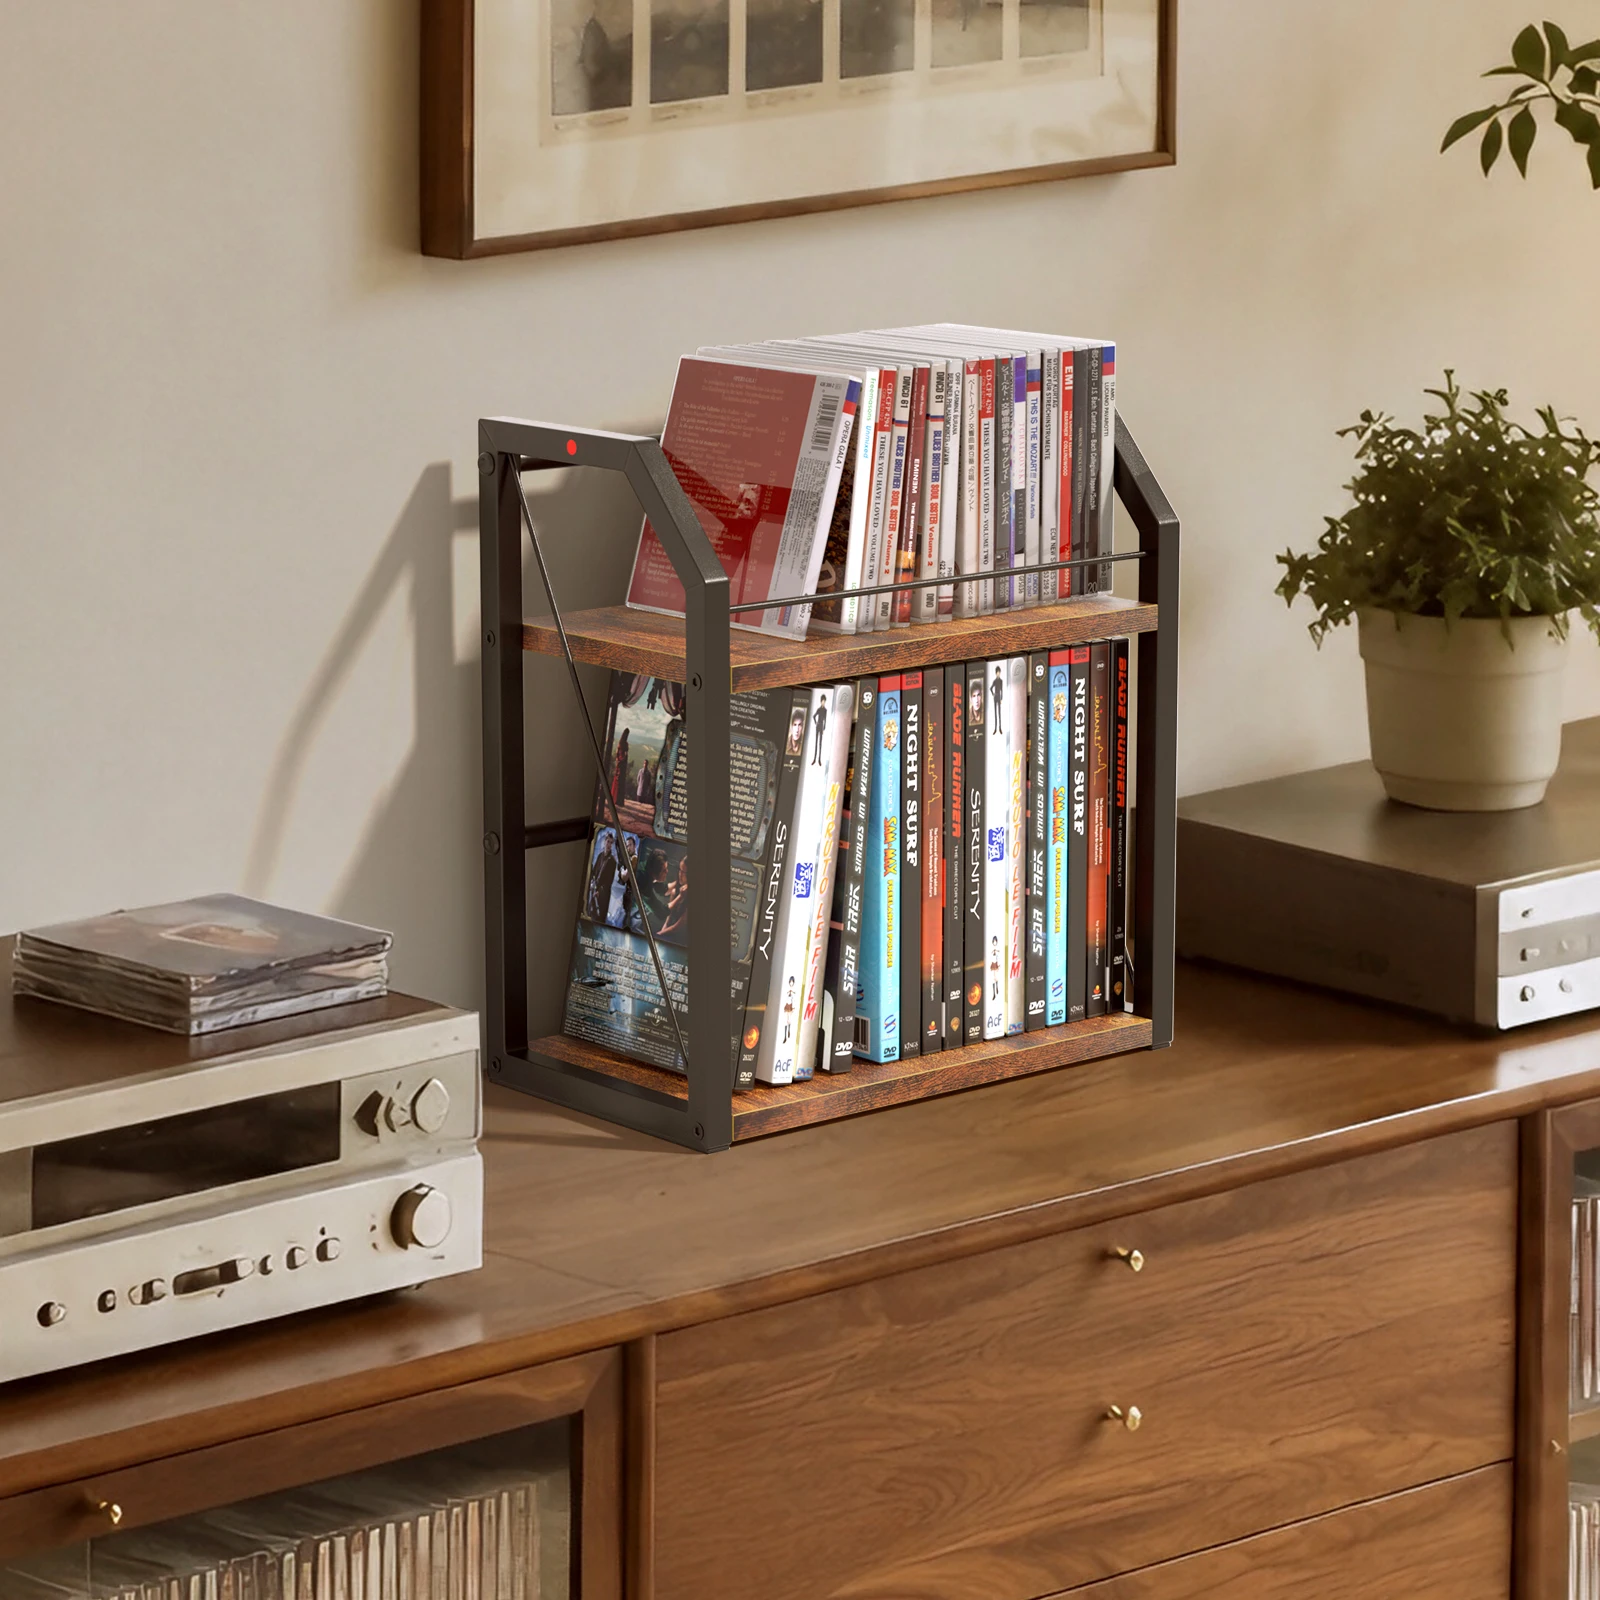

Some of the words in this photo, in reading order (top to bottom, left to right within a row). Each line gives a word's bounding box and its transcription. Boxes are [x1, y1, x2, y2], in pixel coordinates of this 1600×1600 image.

[903, 376, 911, 398] DINCD
[936, 371, 945, 393] DINCD
[1064, 366, 1073, 391] EMI
[885, 383, 894, 413] CD-CFP
[900, 400, 909, 409] 61
[935, 394, 944, 404] 61
[1030, 397, 1038, 416] THIS
[840, 420, 851, 446] OPERA
[1030, 416, 1038, 425] IS
[1030, 426, 1038, 441] THE
[1090, 411, 1098, 433] Cantatas
[836, 445, 847, 464] GALA
[863, 425, 872, 459] Unmixed
[896, 436, 905, 457] BLUES
[933, 430, 942, 452] BLUES
[982, 446, 990, 464] YOU
[877, 462, 885, 479] YOU
[892, 458, 903, 489] BROTHER
[931, 453, 941, 483] BROTHER
[982, 465, 990, 487] HAVE
[1089, 453, 1097, 477] Collegium
[891, 490, 900, 507] SOUL
[930, 484, 940, 500] SOUL
[982, 488, 990, 514] LOVED
[872, 502, 881, 528] LOVED
[888, 509, 899, 532] SISTER
[929, 502, 939, 525] SISTER
[870, 533, 878, 563] VOLUME
[885, 534, 893, 566] Volume
[927, 526, 935, 558] Volume
[926, 593, 934, 608] DINO
[1088, 581, 1098, 593] 20
[881, 602, 889, 617] DINO
[1117, 656, 1127, 719] BLADE
[952, 682, 963, 746] BLADE
[1074, 678, 1085, 762] NIGHT
[906, 704, 918, 791] NIGHT
[1036, 700, 1046, 766] WELTRAUM
[860, 727, 872, 798] WELTRAUM
[1116, 723, 1127, 807] RUNNER
[1037, 771, 1045, 787] IM
[951, 752, 962, 838] RUNNER
[1012, 751, 1023, 859] NARUTO
[1053, 786, 1066, 814] SAM
[1073, 770, 1085, 836] SURF
[858, 801, 866, 820] IM
[1036, 793, 1045, 841] SINNLOS
[818, 781, 841, 895] NARUTO
[884, 816, 897, 845] SAM
[906, 800, 918, 867] SURF
[1052, 817, 1065, 846] MAX
[854, 825, 865, 874] SINNLOS
[884, 848, 897, 877] MAX
[969, 788, 981, 920] SERENITY
[1012, 866, 1021, 901] LE
[1033, 849, 1045, 896] TREK
[1055, 847, 1063, 899] FREELANCE
[759, 821, 788, 961] SERENITY
[886, 879, 895, 932] FREELANCE
[814, 902, 826, 939] LE
[846, 883, 861, 934] TREK
[1054, 900, 1062, 934] POLICE
[1009, 907, 1022, 979] FILM
[1032, 908, 1044, 957] STAR
[886, 933, 895, 968] POLICE
[803, 946, 822, 1021] FILM
[843, 945, 857, 996] STAR
[644, 1011, 669, 1023] UNIVERSAL
[1028, 1000, 1046, 1010] DVD
[1051, 1009, 1064, 1017] DVD
[1008, 1021, 1025, 1031] DVD
[835, 1041, 853, 1052] DVD
[883, 1046, 897, 1055] DVD
[796, 1067, 814, 1077] DVD
